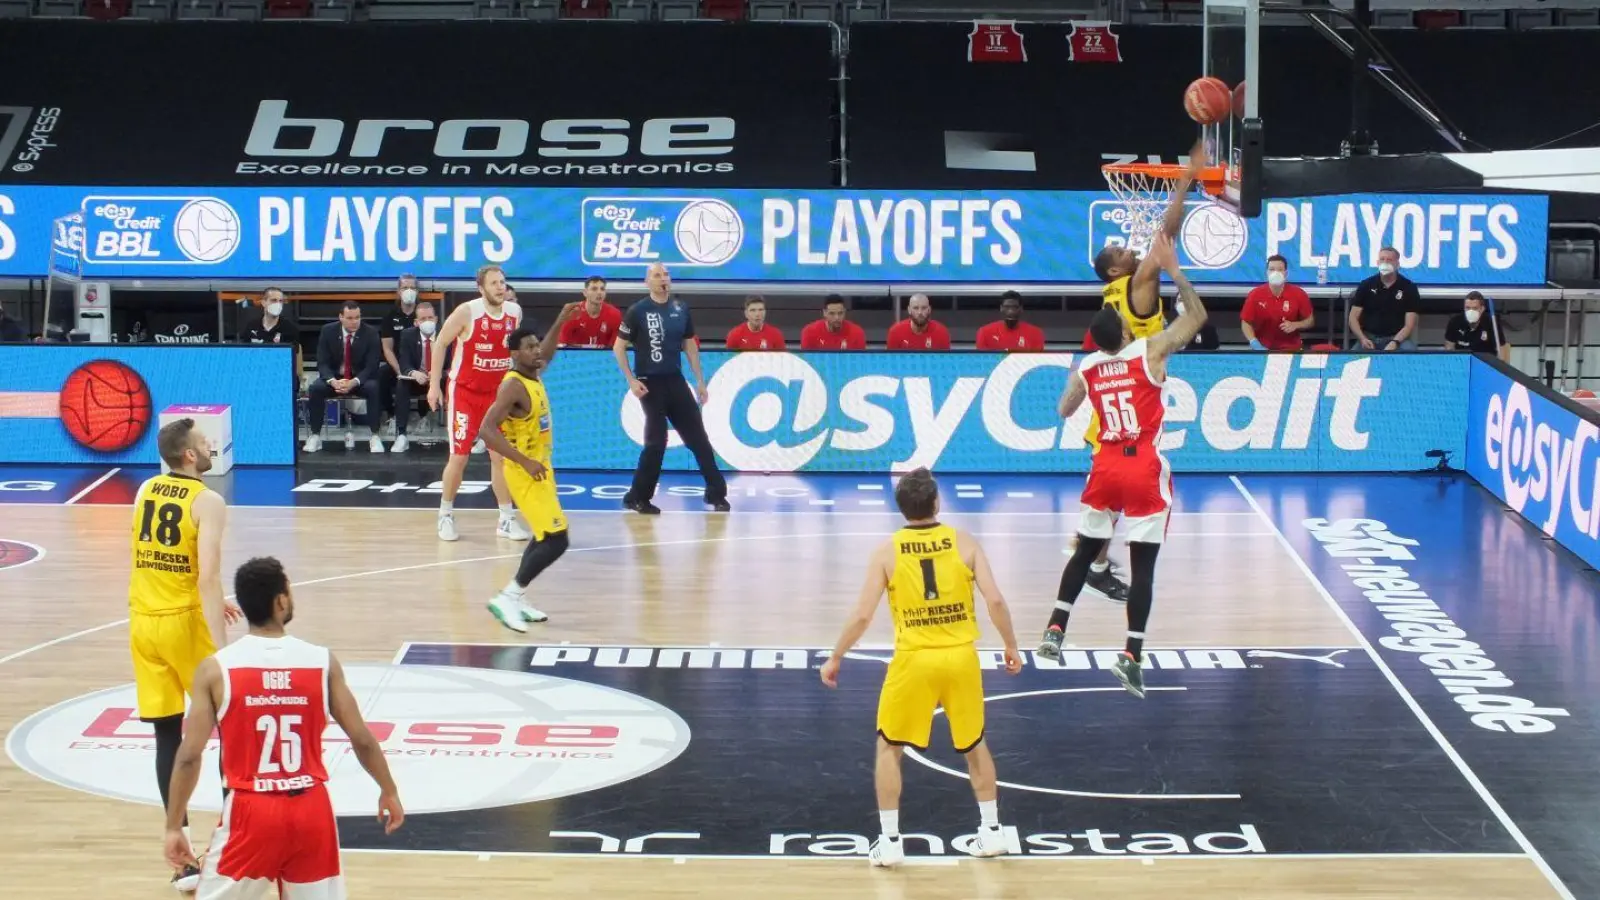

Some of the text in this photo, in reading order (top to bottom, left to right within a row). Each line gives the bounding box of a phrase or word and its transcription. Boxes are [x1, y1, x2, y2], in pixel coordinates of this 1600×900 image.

[1084, 35, 1101, 46] 22
[244, 100, 735, 157] brose
[235, 161, 734, 175] Excellence in Mechatronics
[114, 216, 161, 229] Credit
[259, 196, 514, 262] PLAYOFFS
[613, 217, 661, 231] Credit
[762, 198, 1022, 266] PLAYOFFS
[95, 231, 160, 256] BBL
[594, 232, 660, 259] BBL
[1266, 202, 1518, 269] PLAYOFFS
[646, 312, 663, 362] GYMPER
[1098, 361, 1128, 378] LARSON
[1101, 390, 1138, 433] 55
[152, 482, 189, 499] WOBO
[139, 500, 183, 546] 18
[900, 538, 952, 554] HULLS
[920, 558, 940, 600] 1
[903, 602, 965, 618] MHP RIESEN
[904, 612, 968, 628] LUDWIGSBURG
[530, 647, 808, 669] PUMA
[262, 671, 292, 690] OGBE
[82, 707, 619, 747] bse
[256, 714, 302, 774] 25
[344, 748, 613, 760] echatronics
[254, 775, 315, 792] brose
[769, 824, 1267, 855] randstad
